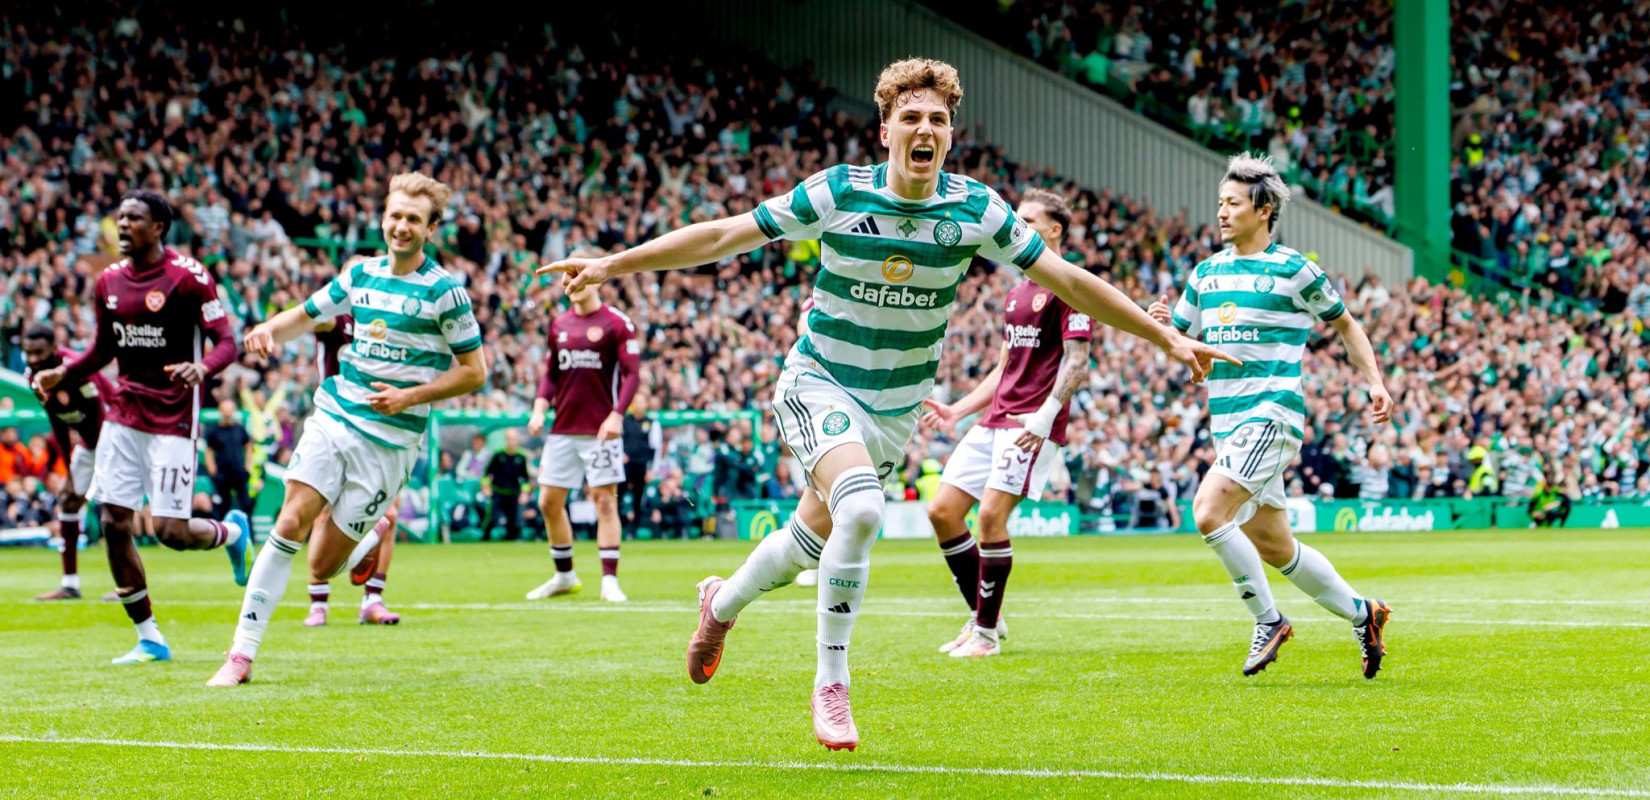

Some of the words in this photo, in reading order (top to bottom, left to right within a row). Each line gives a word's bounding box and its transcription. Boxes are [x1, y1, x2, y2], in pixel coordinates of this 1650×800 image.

[850, 282, 938, 307] dafabet
[125, 324, 164, 336] Stellar
[1014, 325, 1041, 337] Stellar
[1206, 327, 1259, 343] dafabet
[126, 336, 167, 347] Omada
[1231, 426, 1254, 448] 8
[591, 450, 612, 469] 23
[998, 448, 1015, 470] 5
[160, 467, 178, 494] 11
[365, 489, 387, 517] 8
[1007, 507, 1071, 537] fabet
[829, 577, 861, 589] CELTIC
